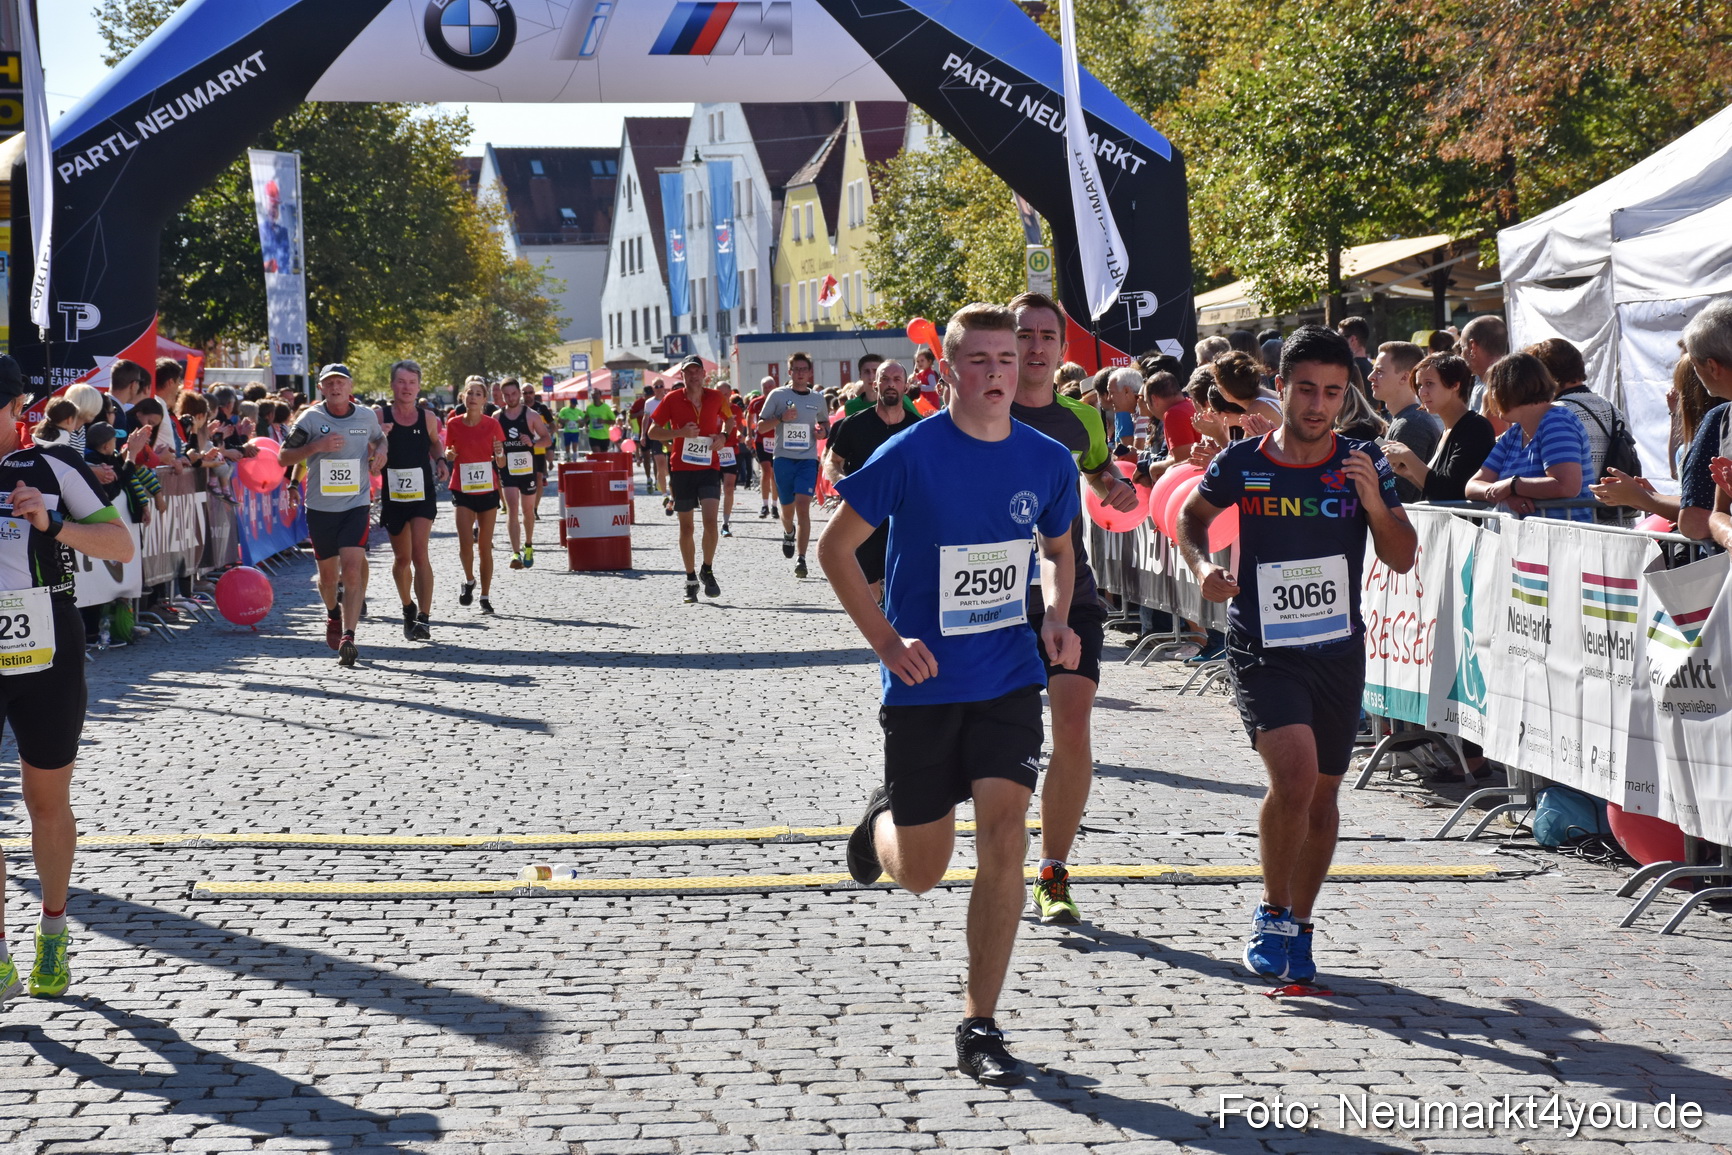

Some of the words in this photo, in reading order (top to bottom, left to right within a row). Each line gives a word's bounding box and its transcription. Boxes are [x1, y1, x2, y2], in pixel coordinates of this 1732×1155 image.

[57, 130, 139, 184] PARTL
[135, 50, 267, 140] NEUMARKT
[942, 53, 1013, 107] PARTL
[1017, 94, 1147, 175] NEUARKT
[1111, 357, 1129, 366] THE
[43, 367, 61, 377] HE
[63, 368, 89, 377] NEXT
[30, 376, 44, 385] 100
[47, 376, 76, 386] EARS
[787, 431, 807, 439] 2343
[687, 443, 708, 453] 2241
[513, 458, 527, 466] 336
[330, 469, 351, 481] 352
[468, 471, 484, 480] 147
[399, 478, 412, 489] 72
[1241, 497, 1358, 518] MENSCH
[968, 550, 1008, 562] BOCK
[1282, 566, 1323, 578] BOCK
[954, 564, 1017, 597] 2590
[981, 597, 1005, 605] Neumarkt
[1272, 580, 1336, 611] 3066
[0, 654, 33, 667] istina
[1677, 700, 1717, 714] genießen
